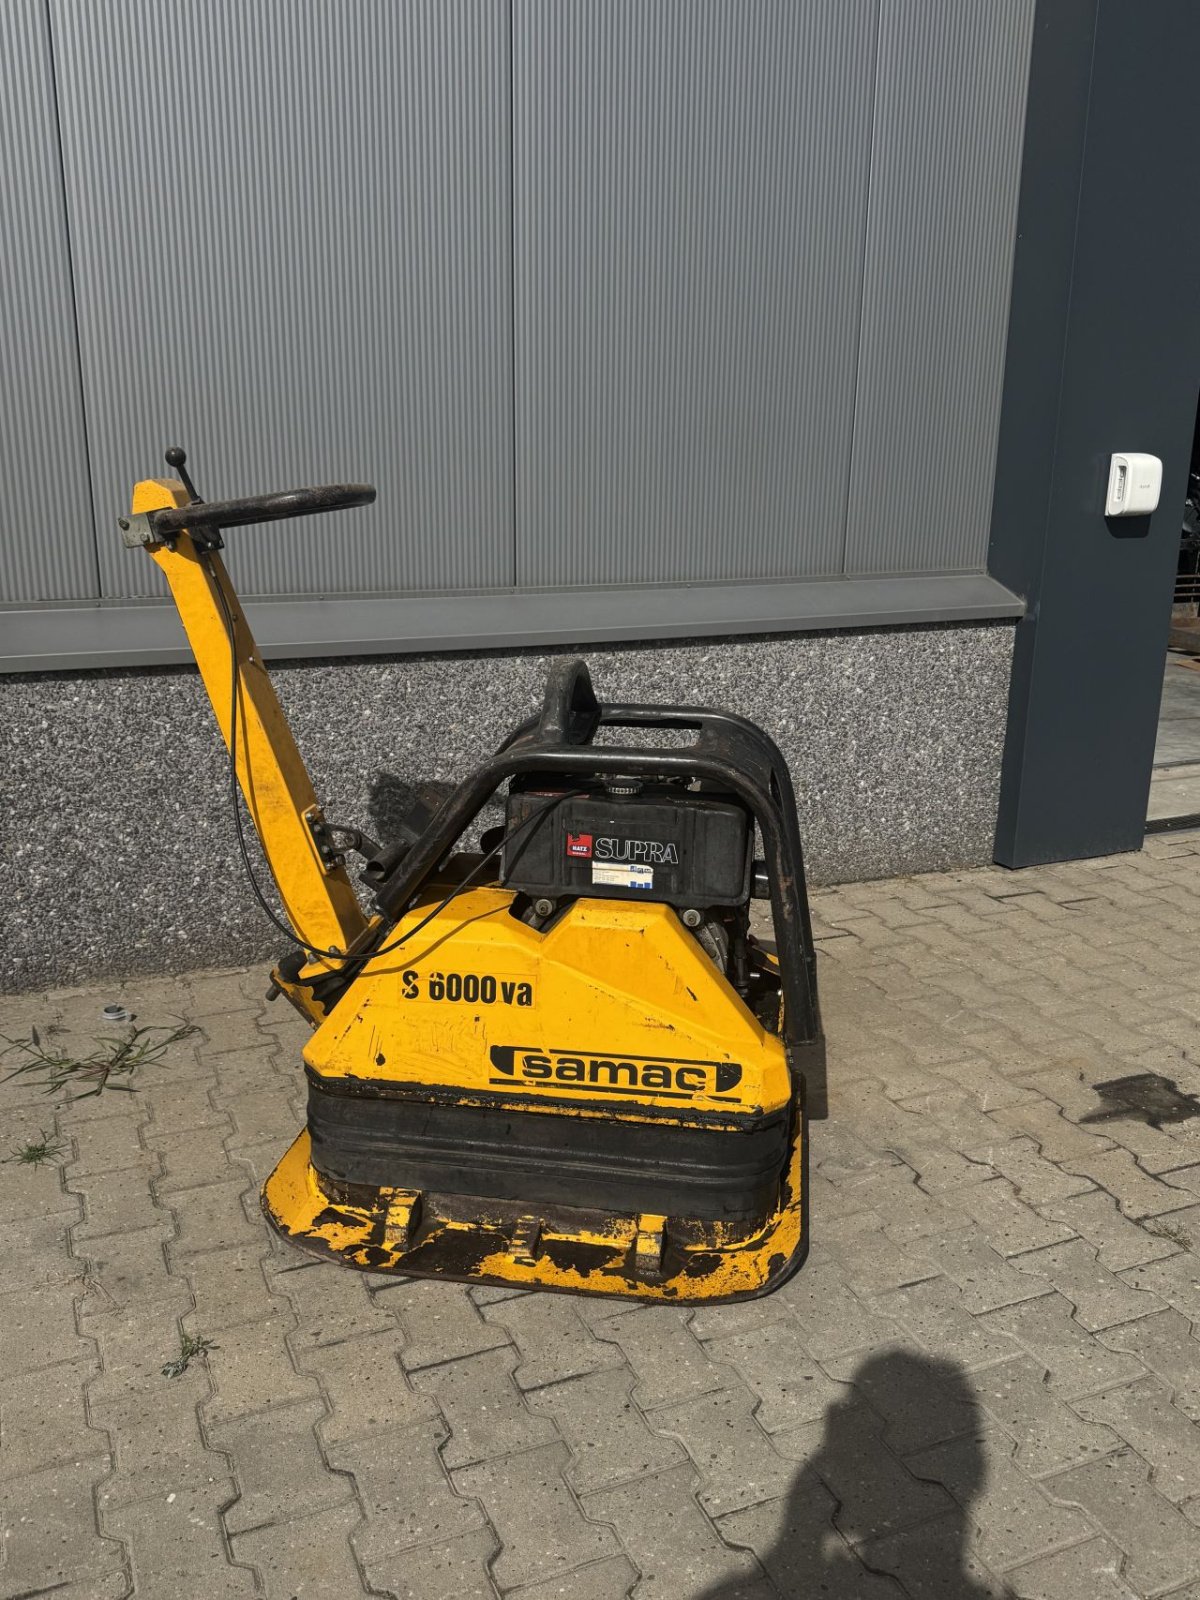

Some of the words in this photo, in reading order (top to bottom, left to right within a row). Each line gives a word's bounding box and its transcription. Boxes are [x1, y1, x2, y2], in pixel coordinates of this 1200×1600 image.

[595, 837, 679, 864] SUPRA
[401, 970, 420, 999] S
[522, 1053, 707, 1091] samac
